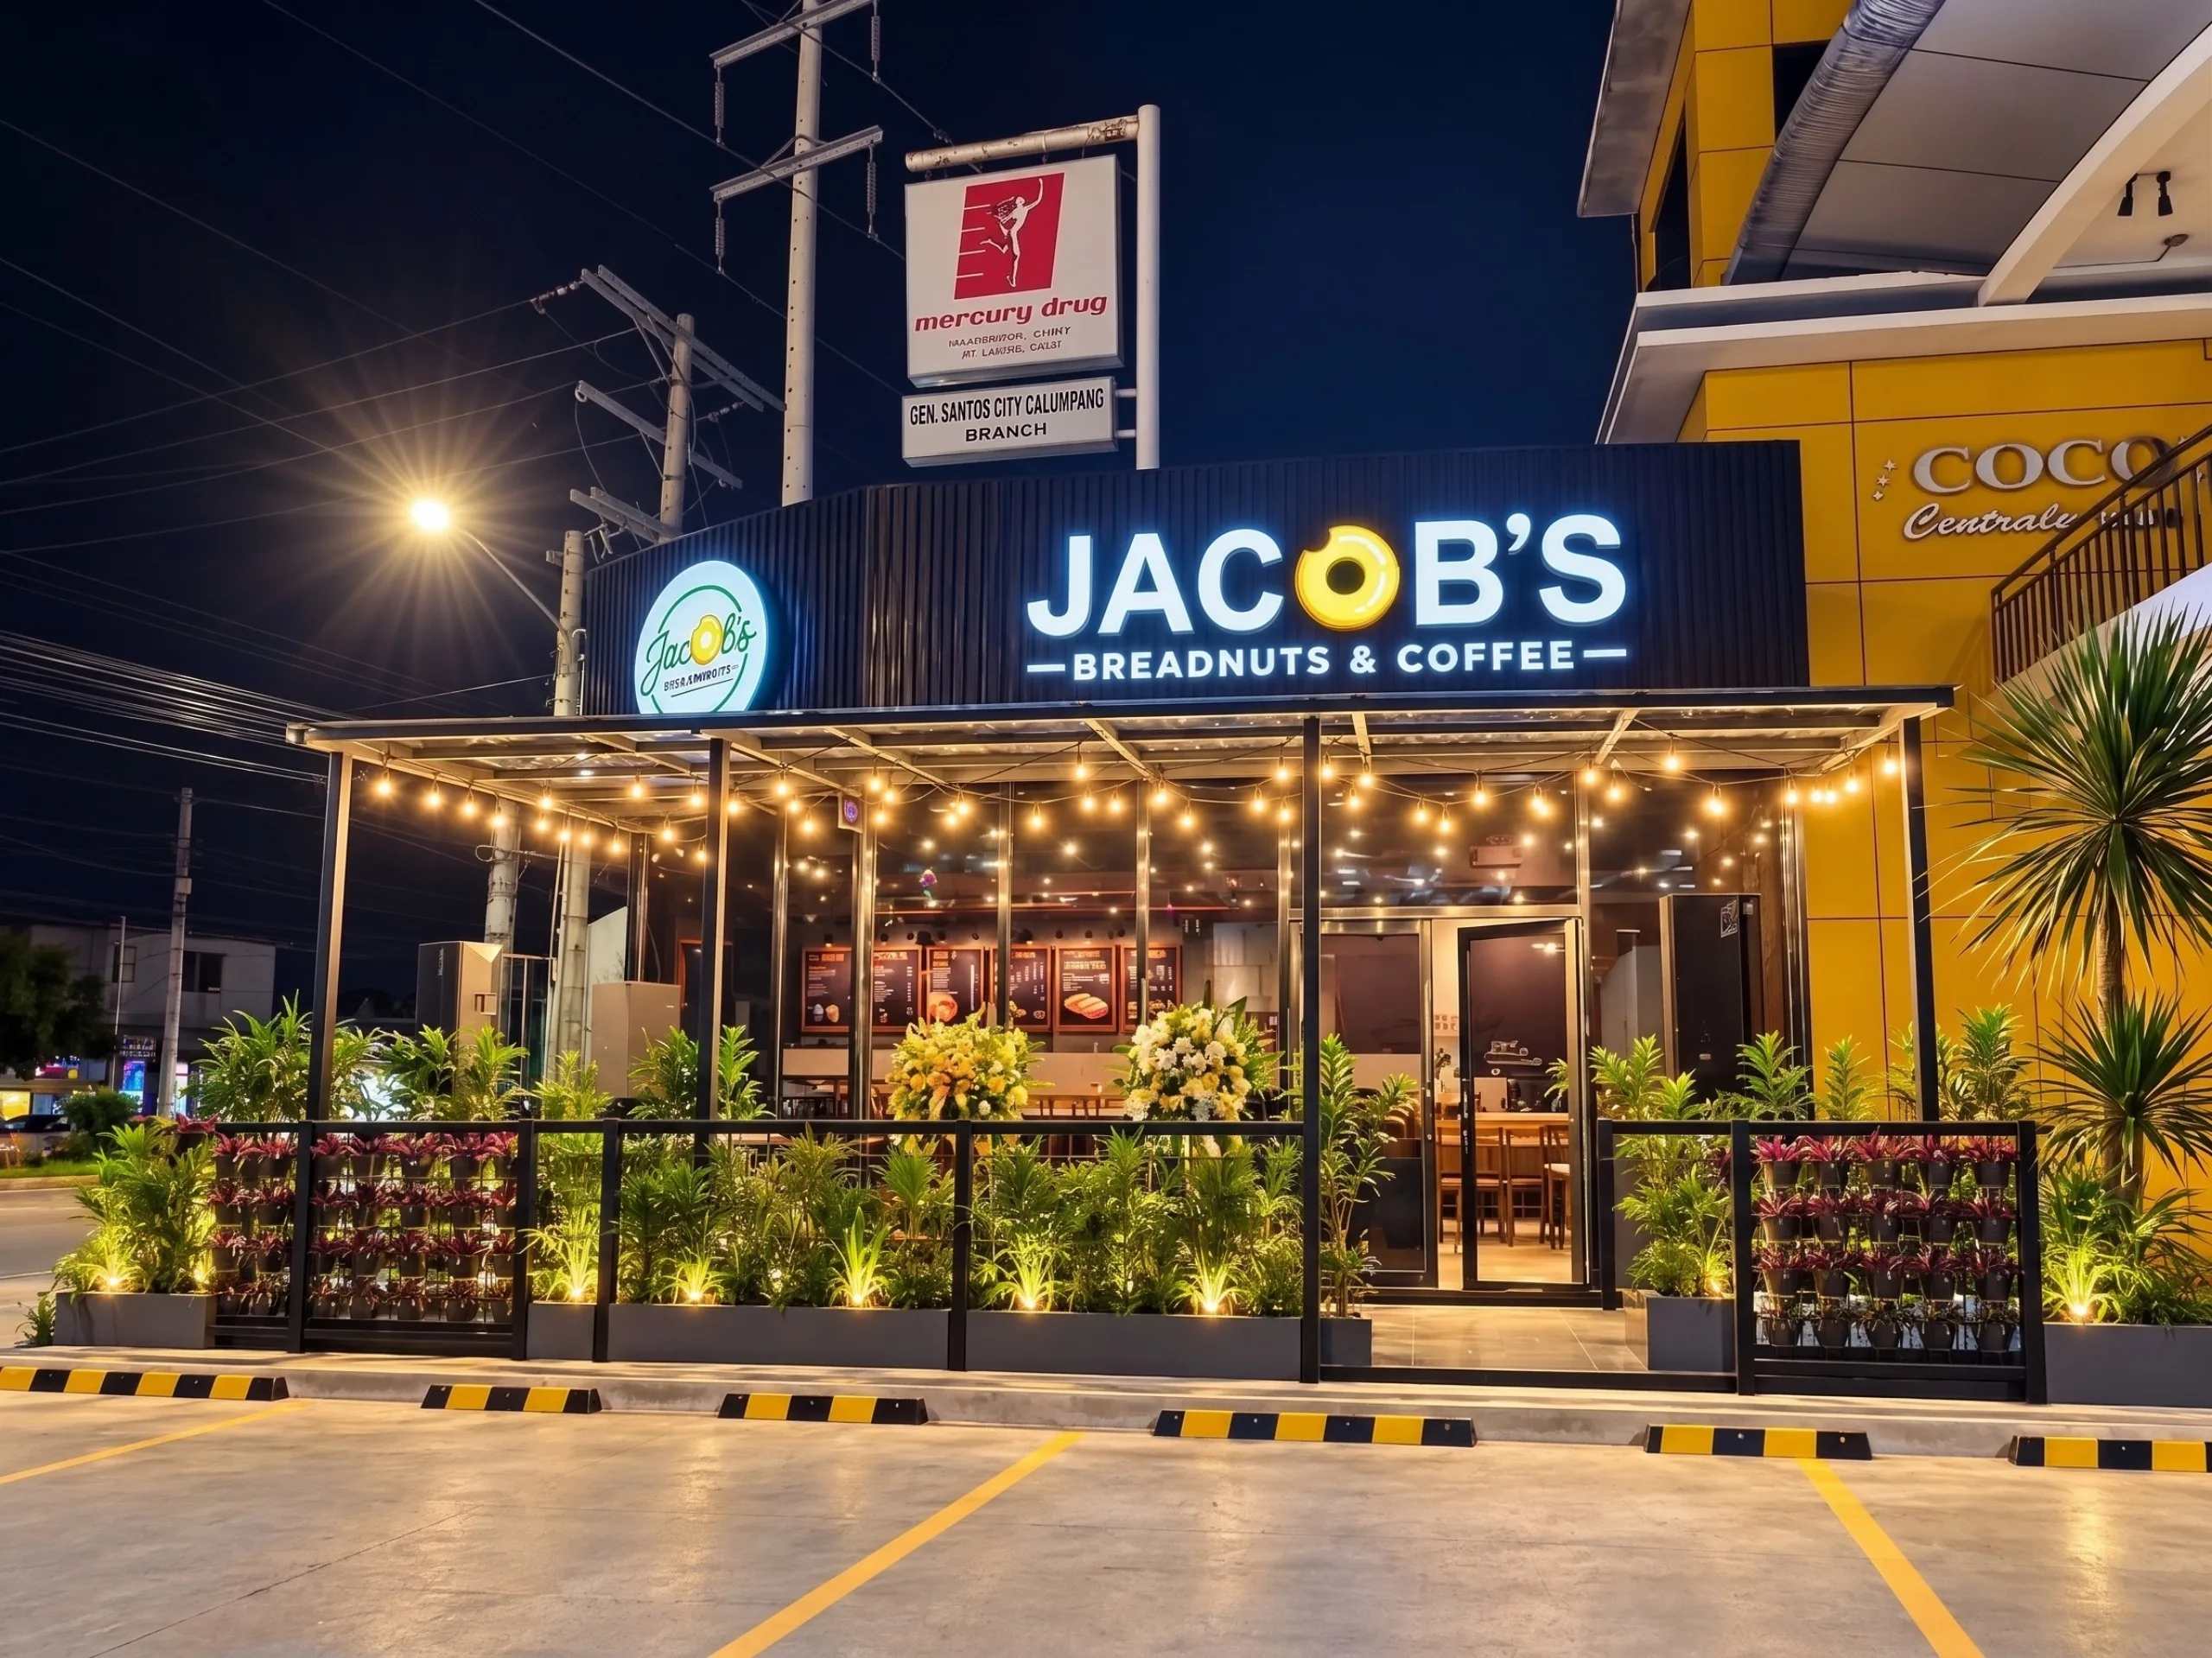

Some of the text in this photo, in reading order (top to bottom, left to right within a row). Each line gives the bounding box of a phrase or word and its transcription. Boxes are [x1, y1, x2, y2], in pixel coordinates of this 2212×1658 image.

[914, 295, 1108, 332] mercury drug
[910, 387, 1104, 426] GEN. SANTOS CITY CALUMPANG
[965, 422, 1047, 442] BRANCH
[1027, 512, 1627, 638] JACOB'S
[1073, 640, 1575, 681] BREADNUTS & COFFEE
